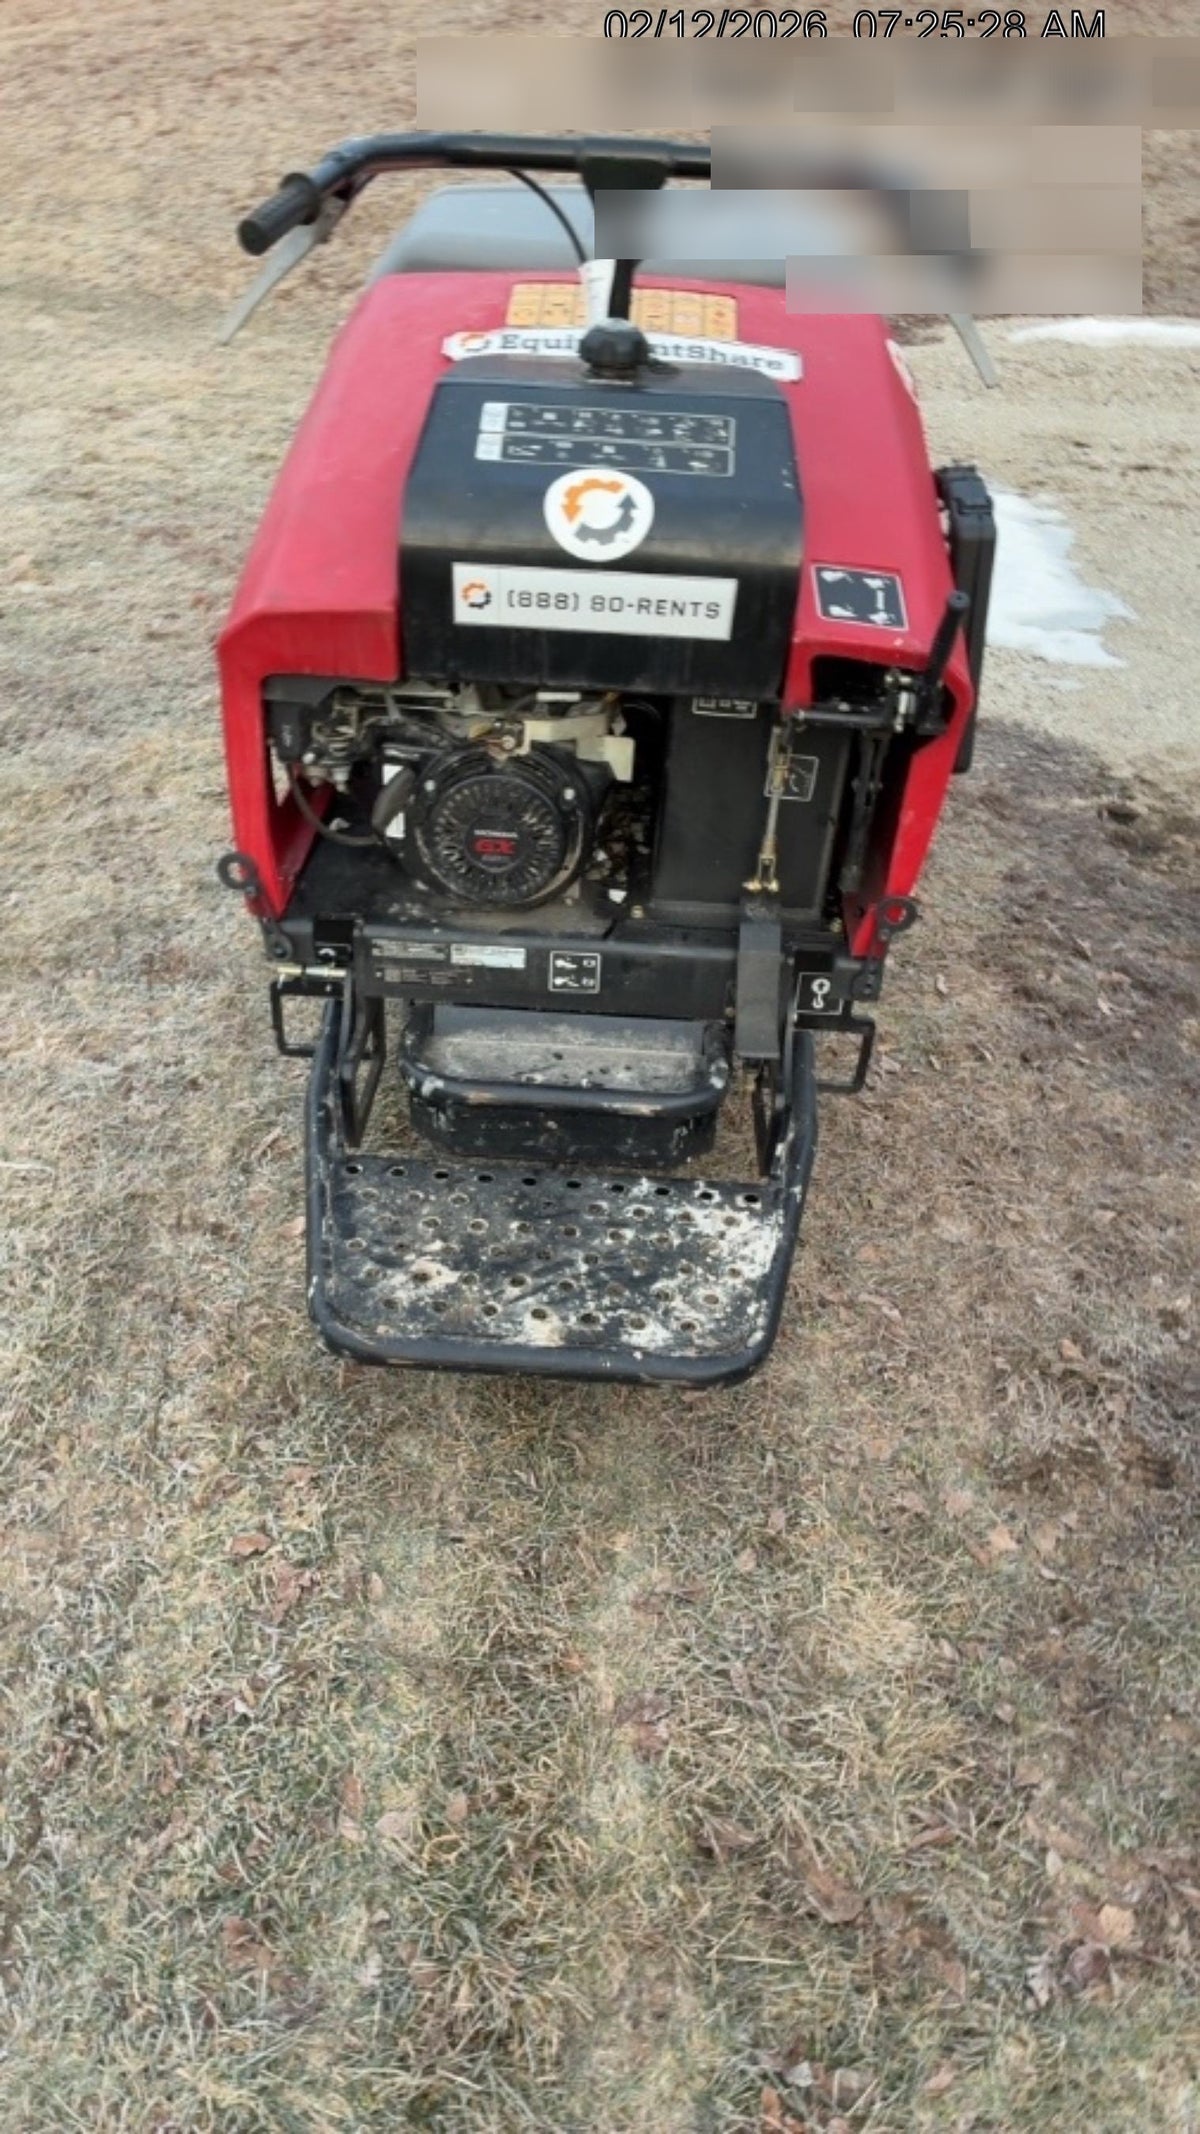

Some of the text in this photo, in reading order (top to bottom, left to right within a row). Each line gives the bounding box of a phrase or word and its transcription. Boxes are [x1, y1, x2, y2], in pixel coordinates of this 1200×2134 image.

[497, 334, 784, 371] EquintShare
[506, 589, 721, 620] (888) 80-RENTS
